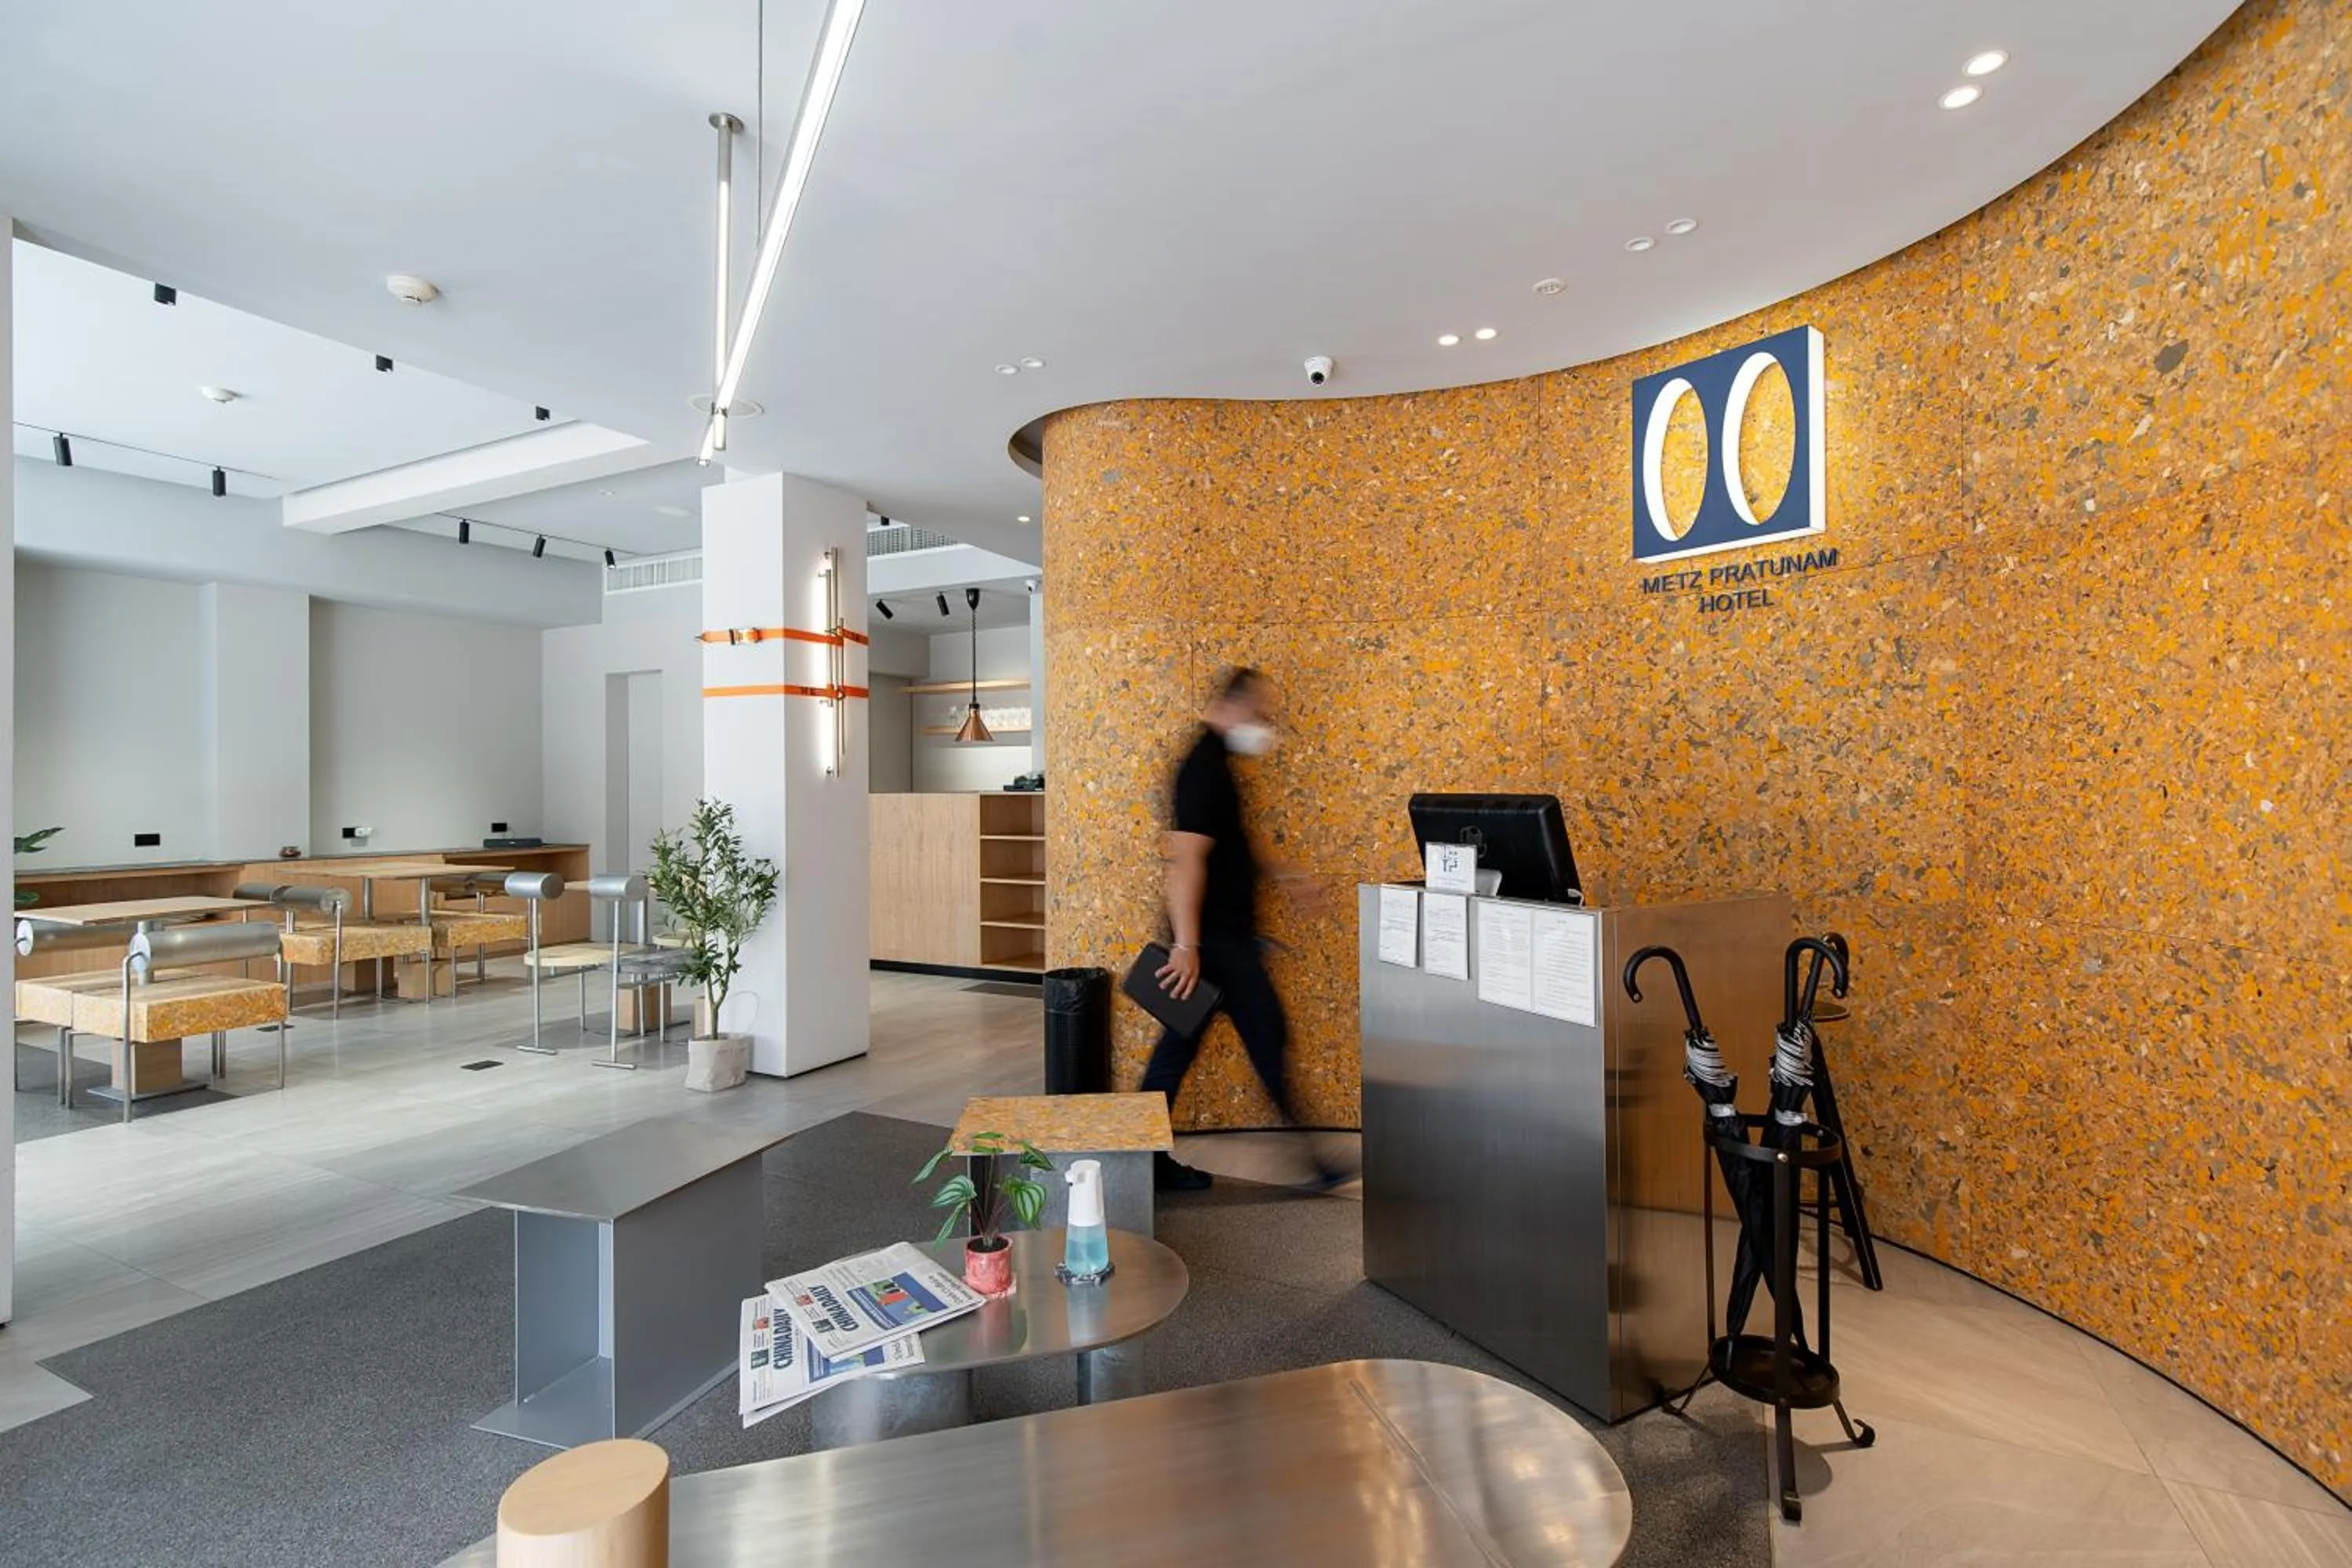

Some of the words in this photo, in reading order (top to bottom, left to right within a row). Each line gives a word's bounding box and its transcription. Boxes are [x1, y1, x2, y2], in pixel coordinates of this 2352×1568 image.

[1642, 570, 1702, 594] METZ
[1709, 548, 1838, 586] PRATUNAM
[1698, 589, 1774, 614] HOTEL
